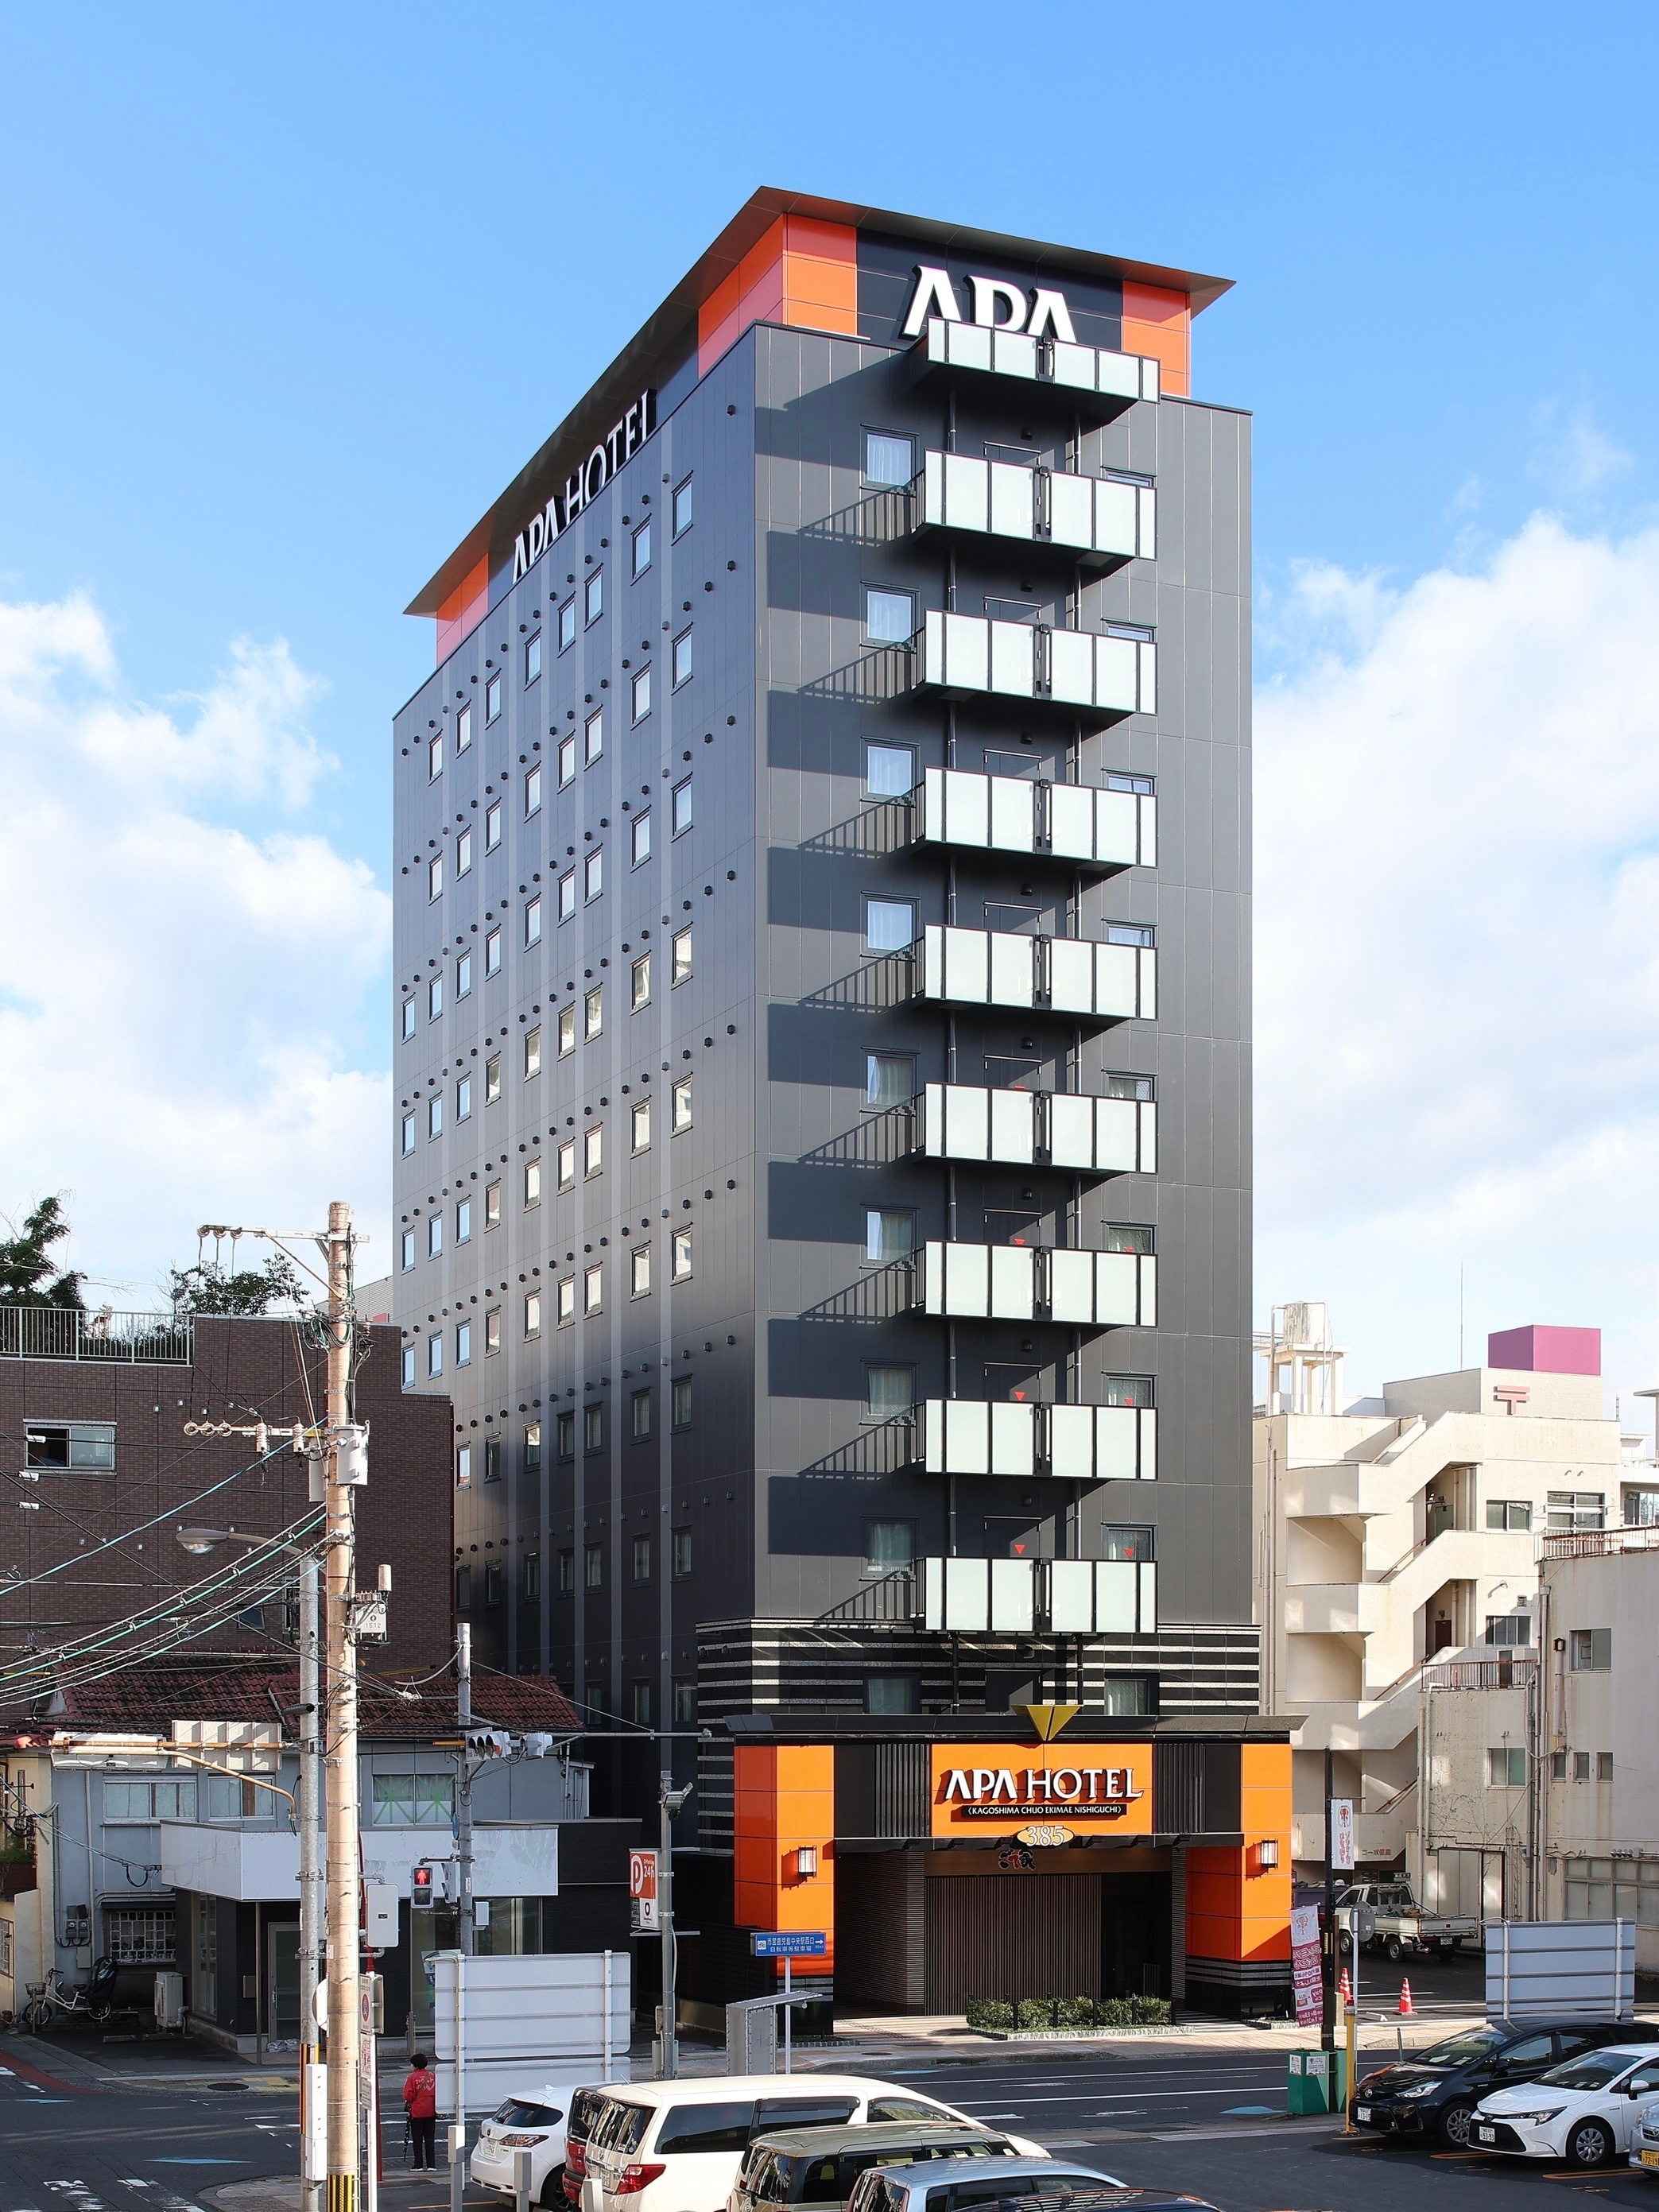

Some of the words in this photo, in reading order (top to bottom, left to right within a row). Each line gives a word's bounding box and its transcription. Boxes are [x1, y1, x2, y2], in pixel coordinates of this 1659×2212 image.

[512, 493, 560, 585] APA
[944, 1768, 1018, 1799] APA
[1025, 1768, 1145, 1799] HOTEL
[1021, 1806, 1044, 1815] CHUO
[1025, 1825, 1065, 1847] 385
[630, 1854, 644, 1895] P
[643, 1865, 655, 1878] 24h
